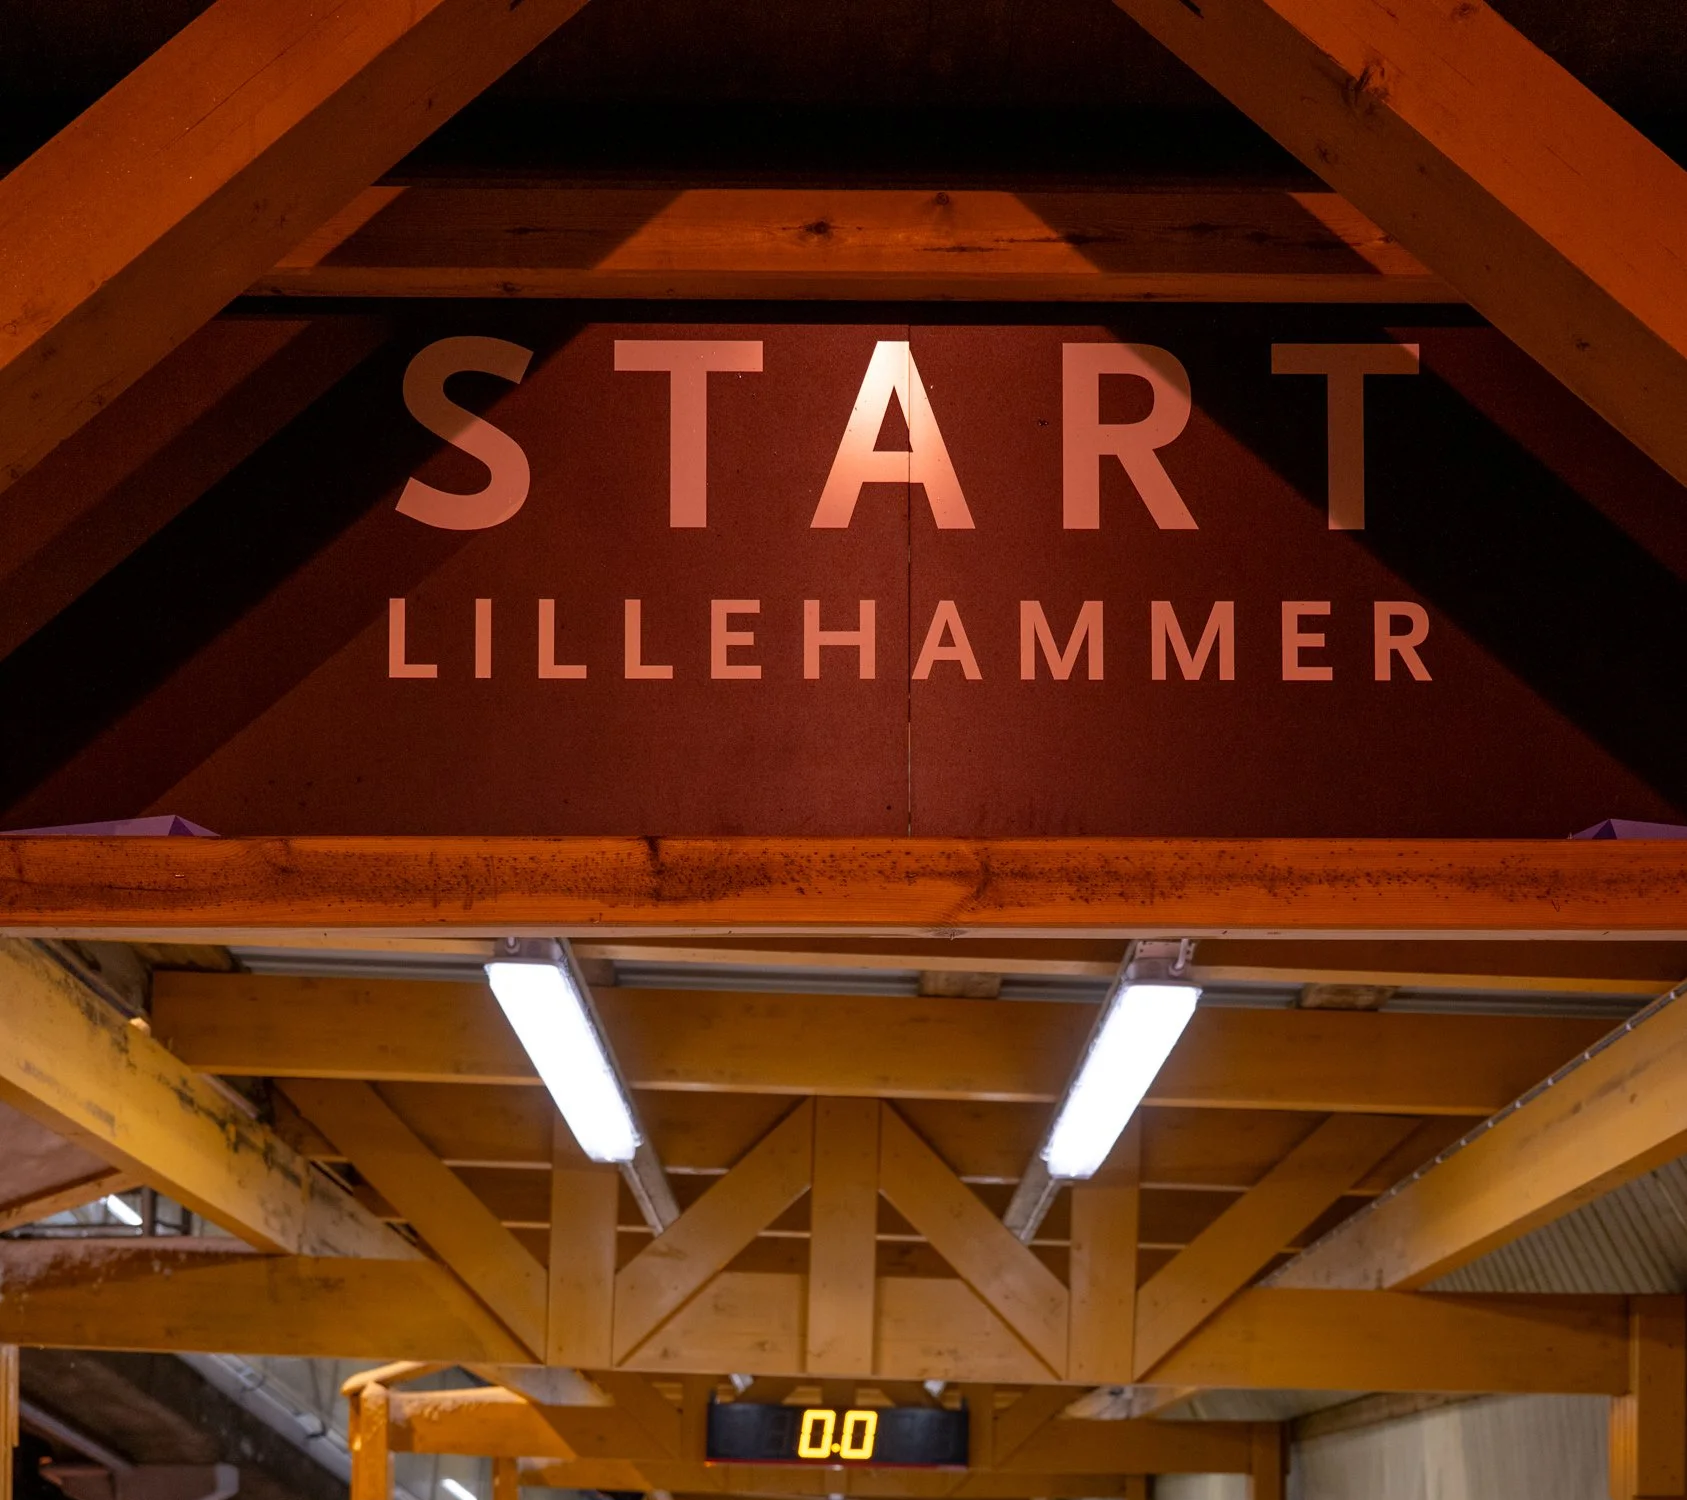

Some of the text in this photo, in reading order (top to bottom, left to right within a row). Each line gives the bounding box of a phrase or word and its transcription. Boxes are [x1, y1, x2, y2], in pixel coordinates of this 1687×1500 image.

[395, 335, 1420, 532] START
[388, 597, 1433, 683] LILLEHAMMER
[797, 1409, 878, 1460] 0.0
